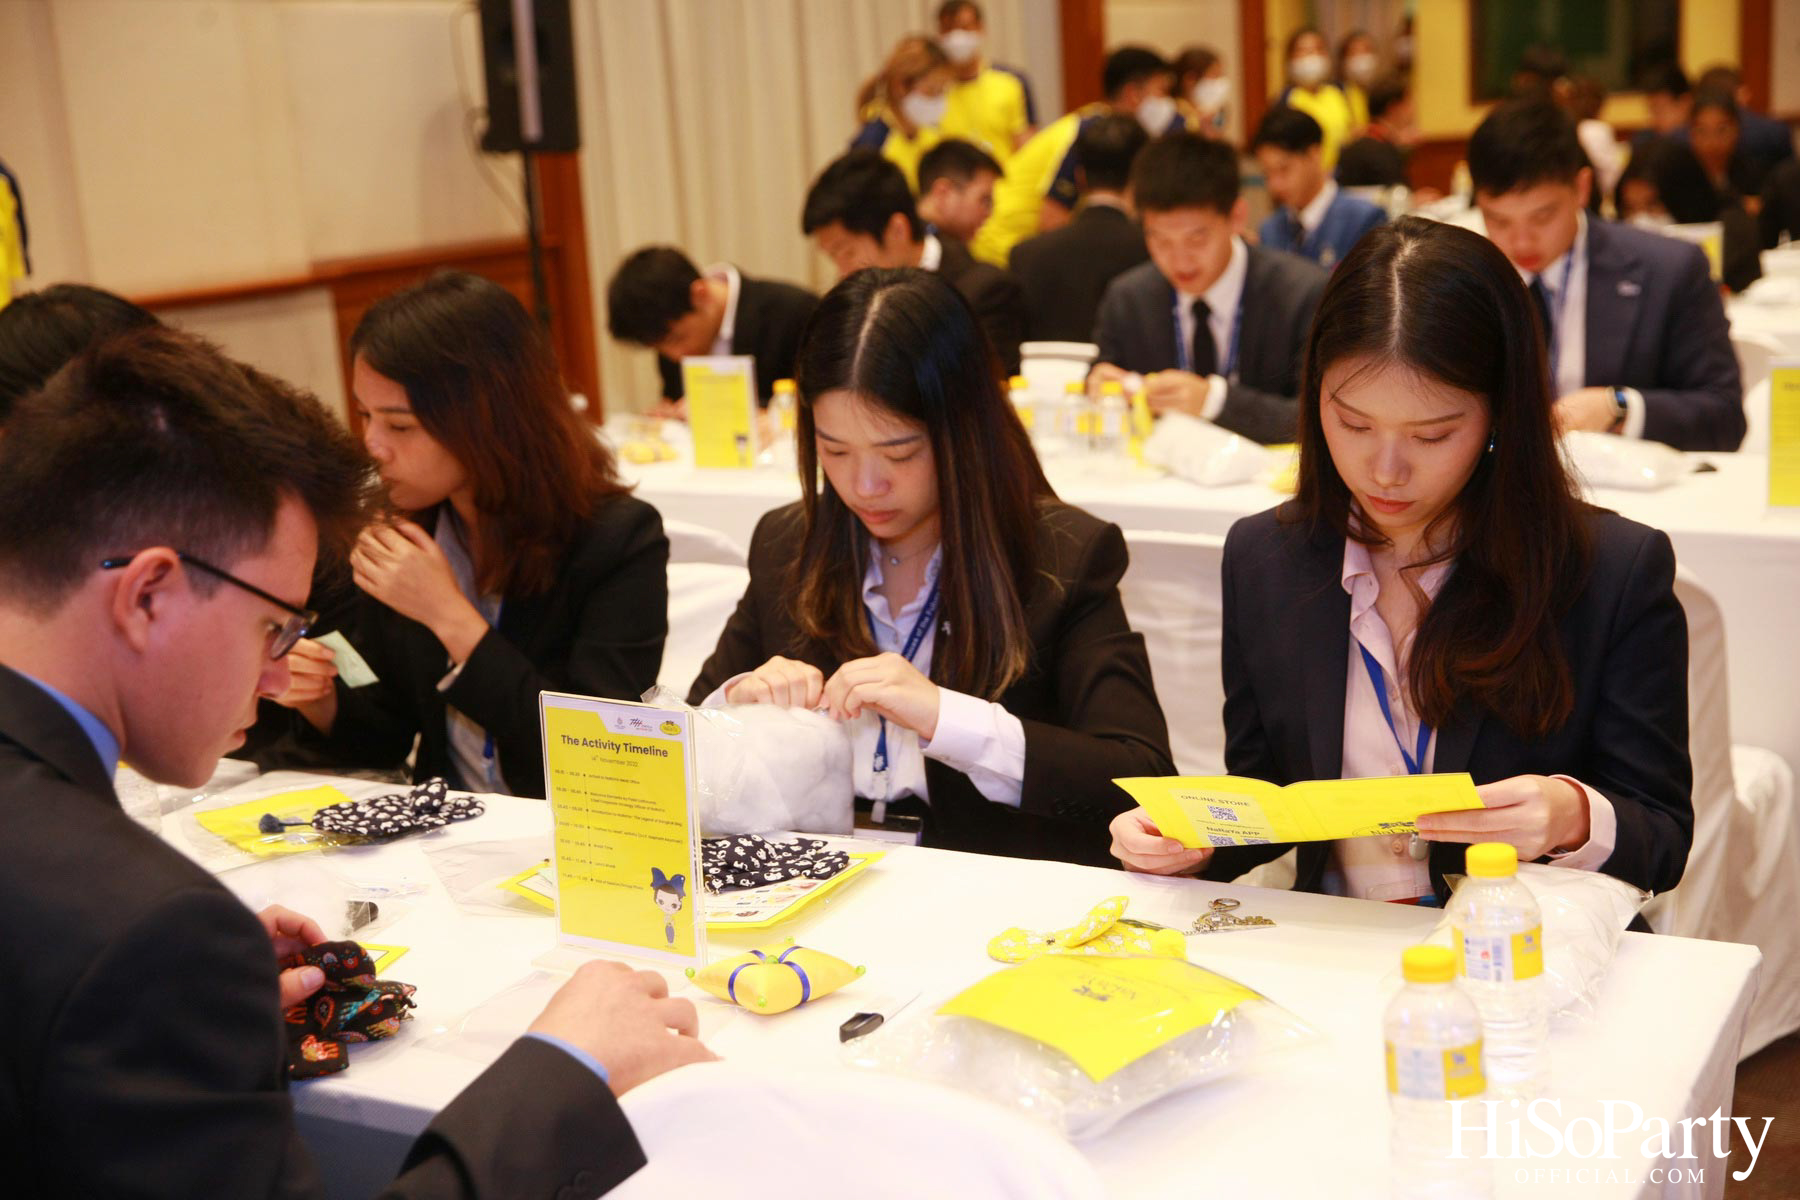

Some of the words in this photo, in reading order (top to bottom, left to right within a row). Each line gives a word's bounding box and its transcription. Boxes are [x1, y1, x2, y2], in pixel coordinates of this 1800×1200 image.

[561, 734, 580, 746] The
[582, 737, 621, 754] Activity
[623, 742, 668, 758] Timeline
[1180, 794, 1217, 803] ONLINE
[1217, 799, 1250, 807] STORE
